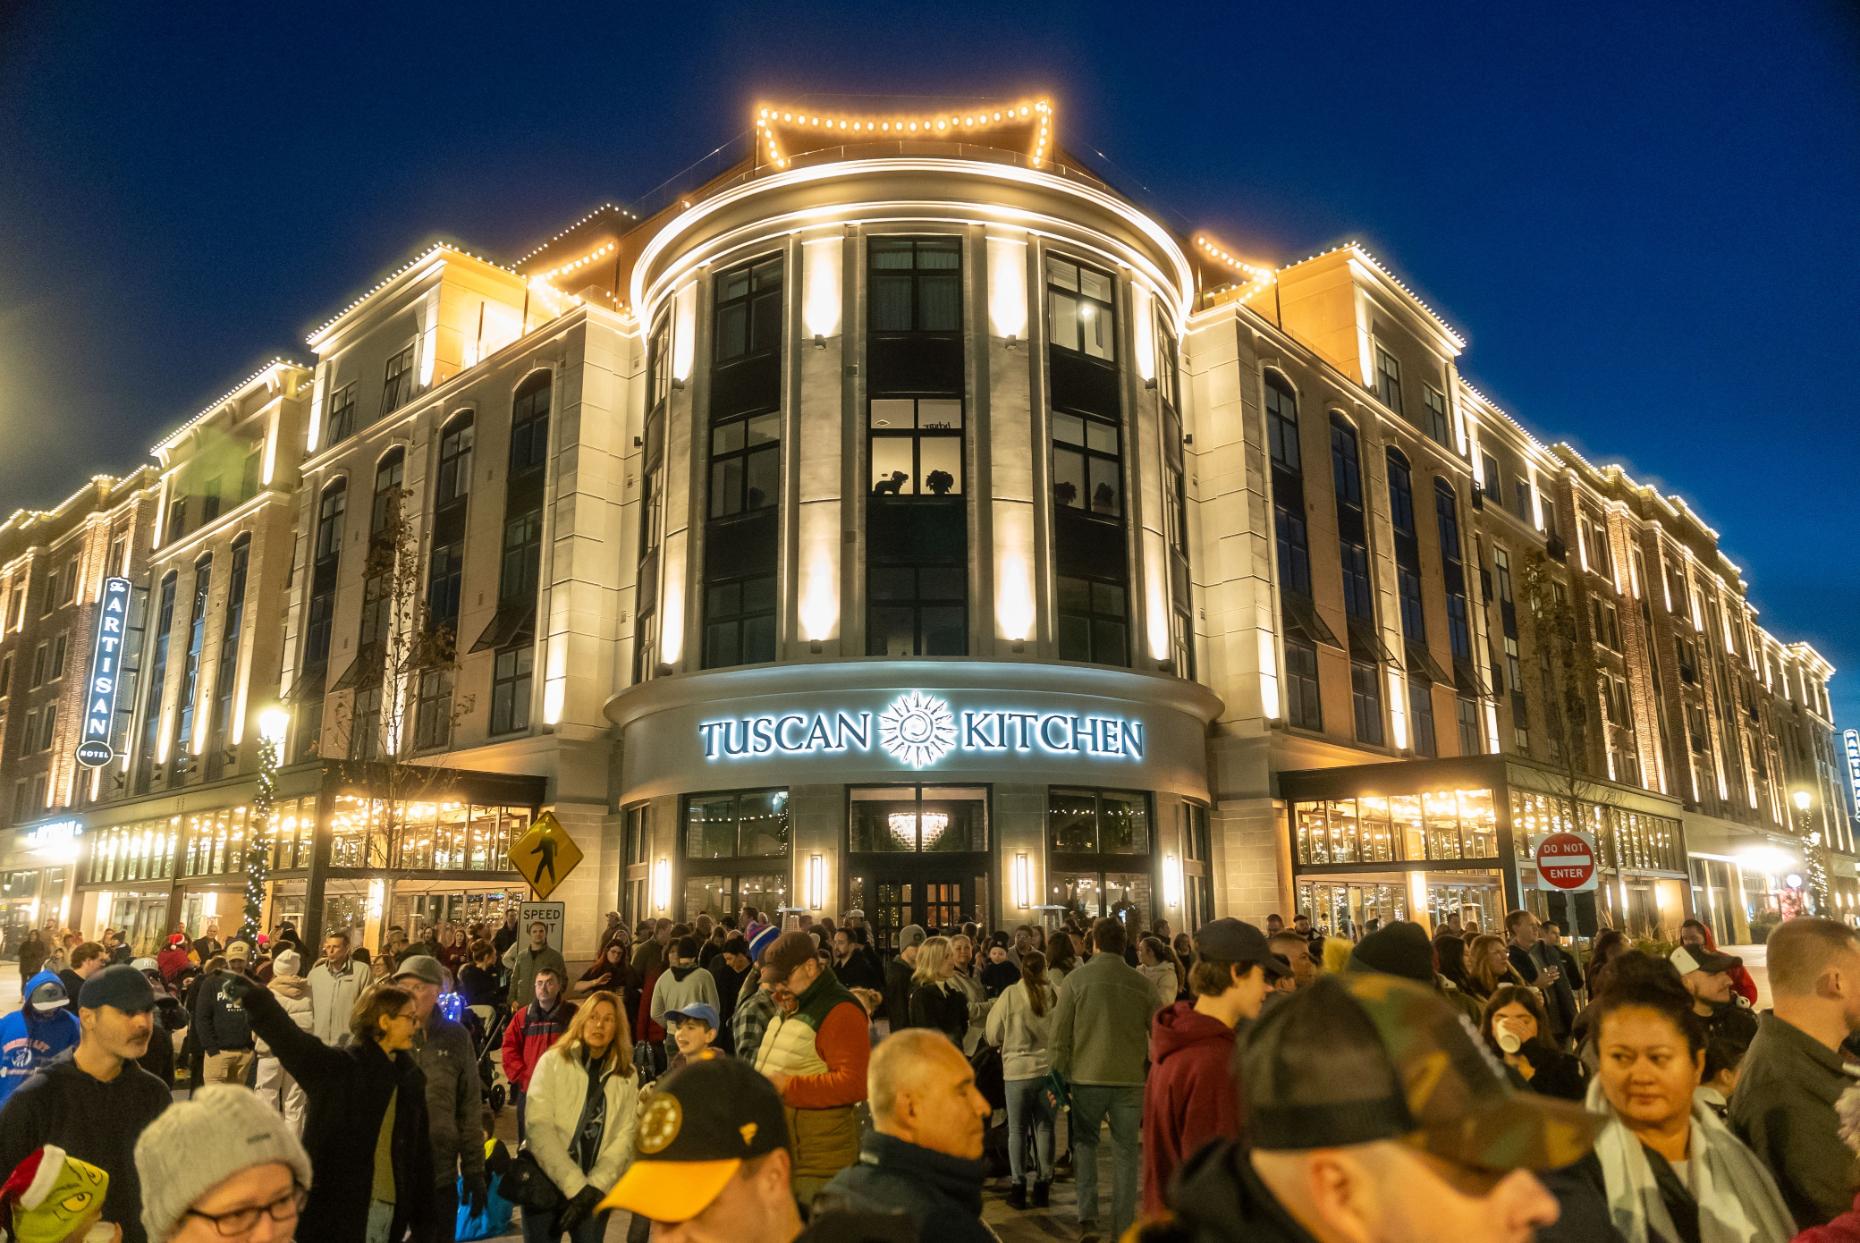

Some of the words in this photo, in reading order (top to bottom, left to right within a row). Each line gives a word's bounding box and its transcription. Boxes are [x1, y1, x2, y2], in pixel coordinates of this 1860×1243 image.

[88, 596, 123, 736] ARTISAN
[698, 712, 872, 758] TUSCAN
[963, 711, 1145, 759] KITCHEN
[80, 749, 109, 759] HOTEL
[1543, 844, 1558, 853] DO
[1563, 842, 1584, 853] NOT
[1550, 868, 1583, 878] ENTER
[523, 909, 561, 920] SPEED
